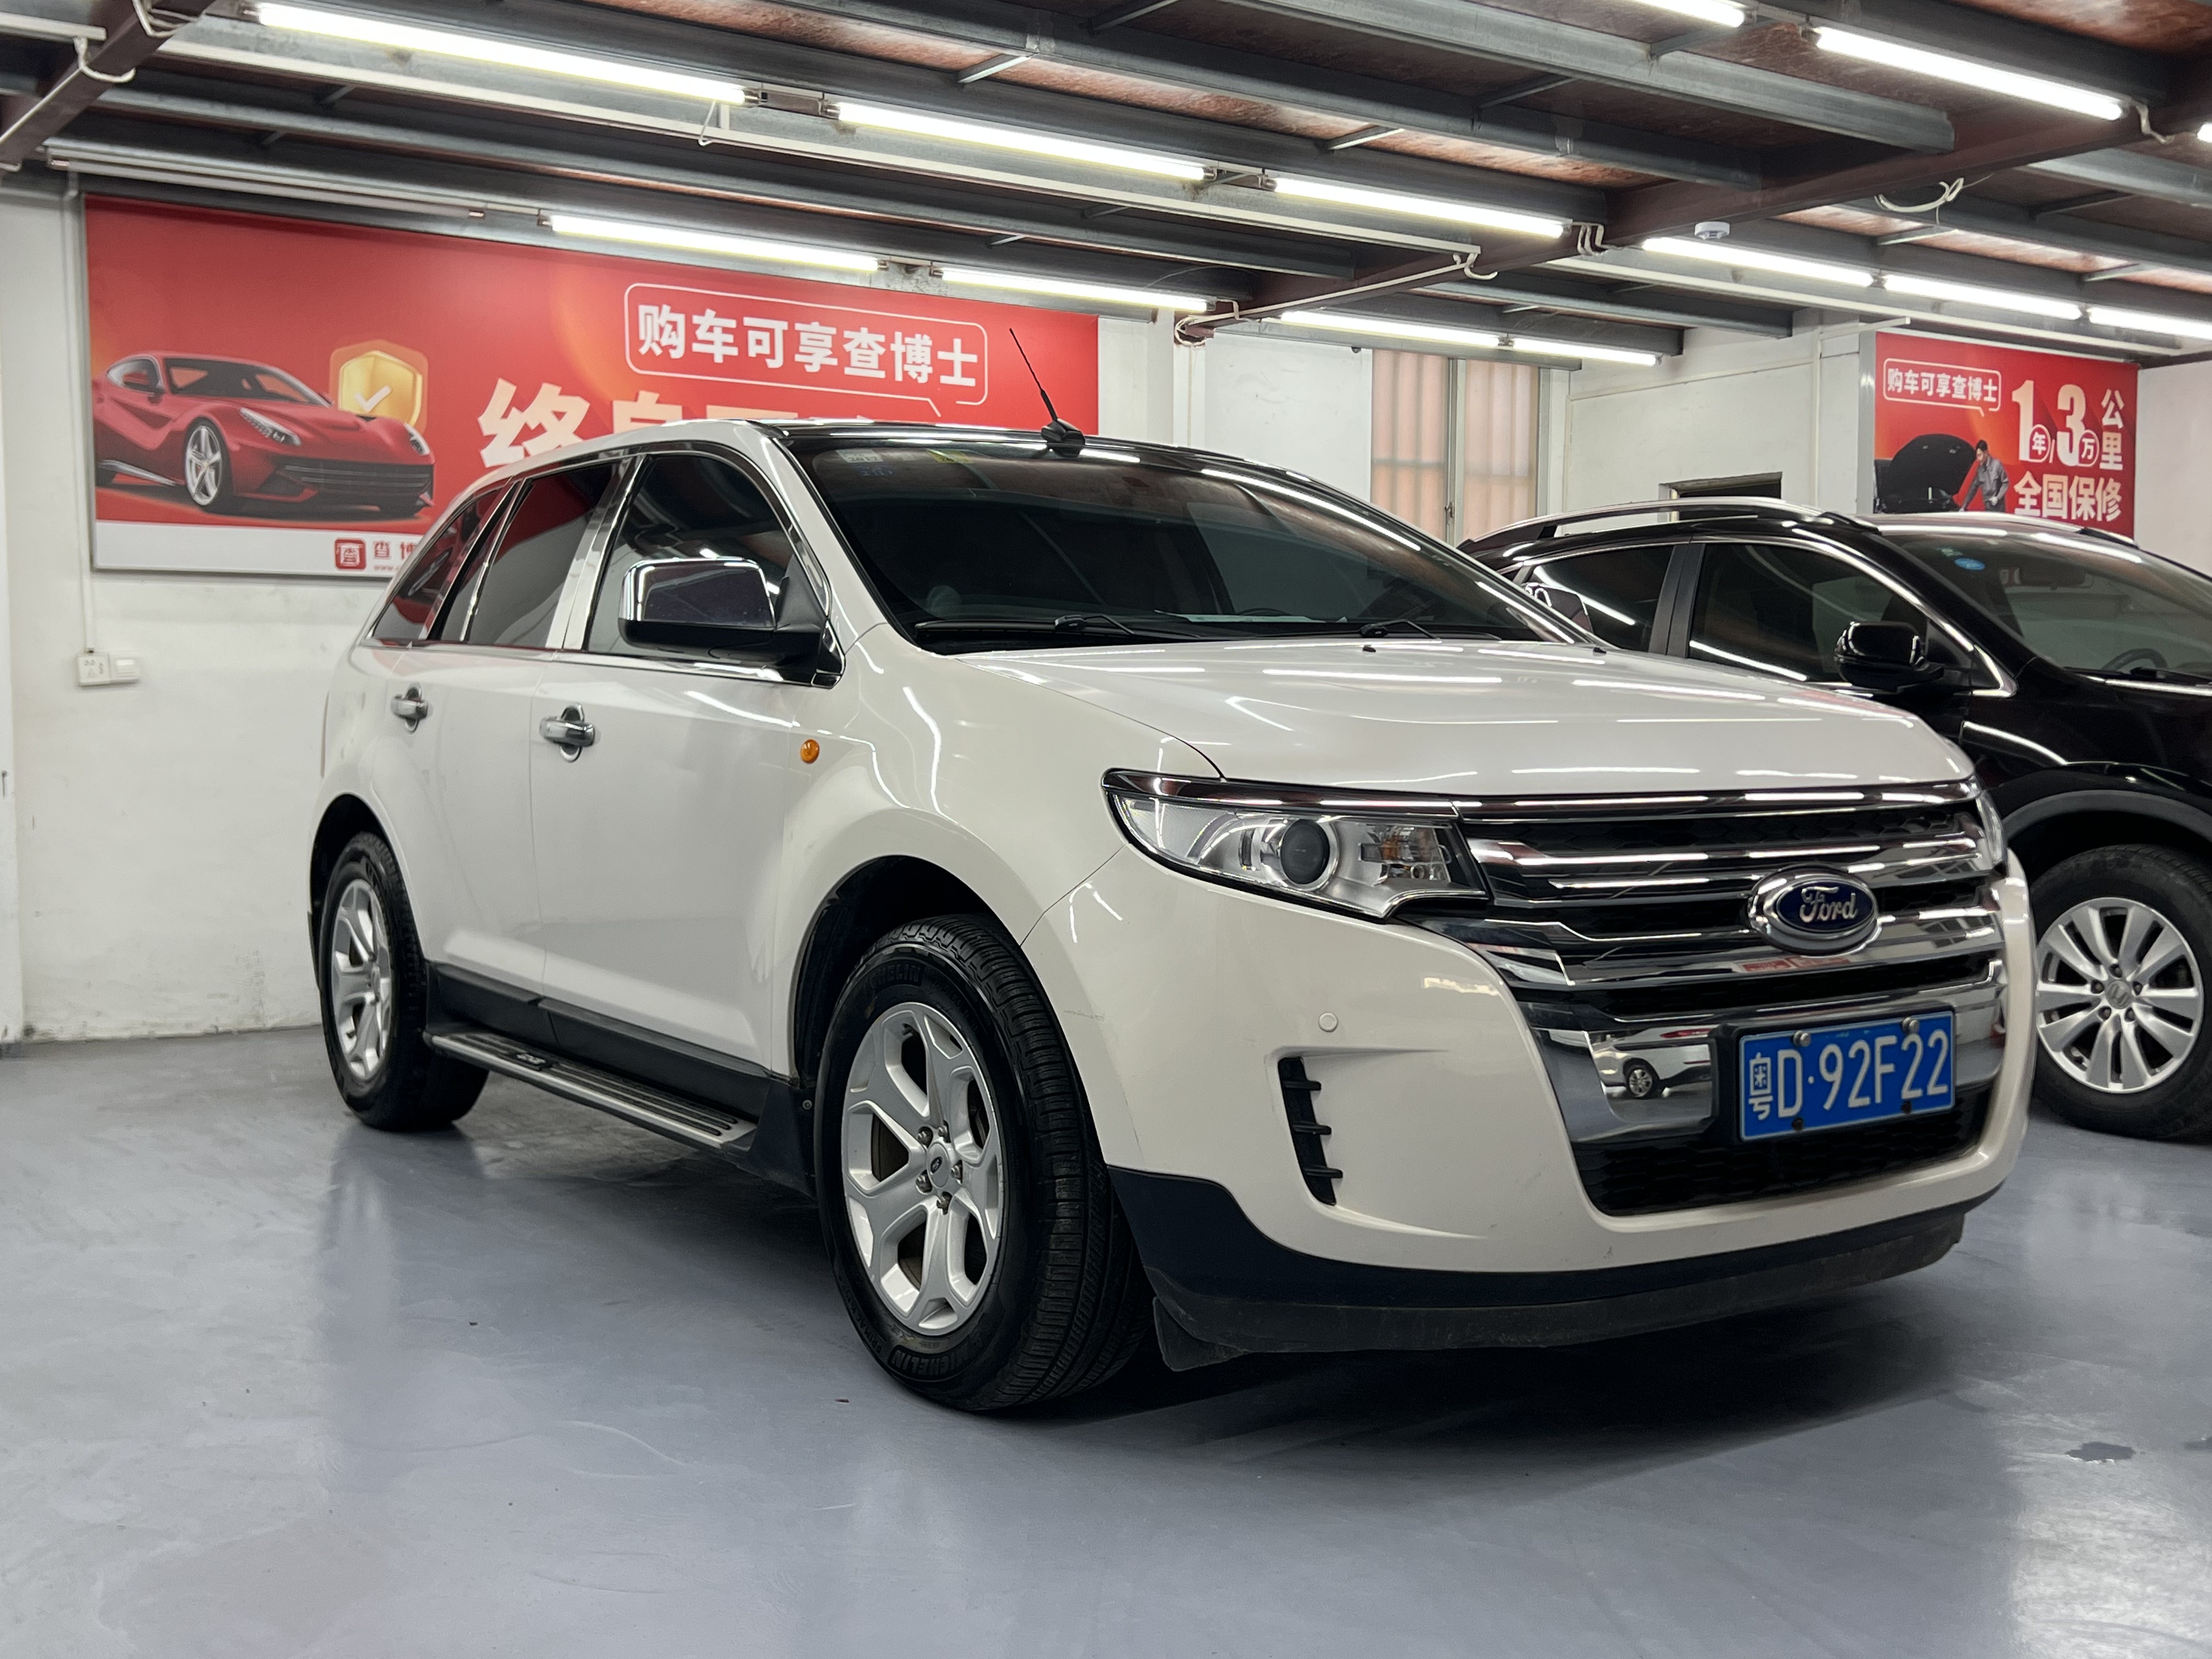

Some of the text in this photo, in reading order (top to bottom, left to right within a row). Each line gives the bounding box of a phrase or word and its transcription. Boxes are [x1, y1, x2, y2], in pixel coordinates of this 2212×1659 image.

[637, 304, 979, 387] 购车可享查博士
[1887, 368, 1999, 403] 购车可享查博士
[2014, 471, 2122, 522] 全国保修
[1799, 885, 1858, 923] Ford
